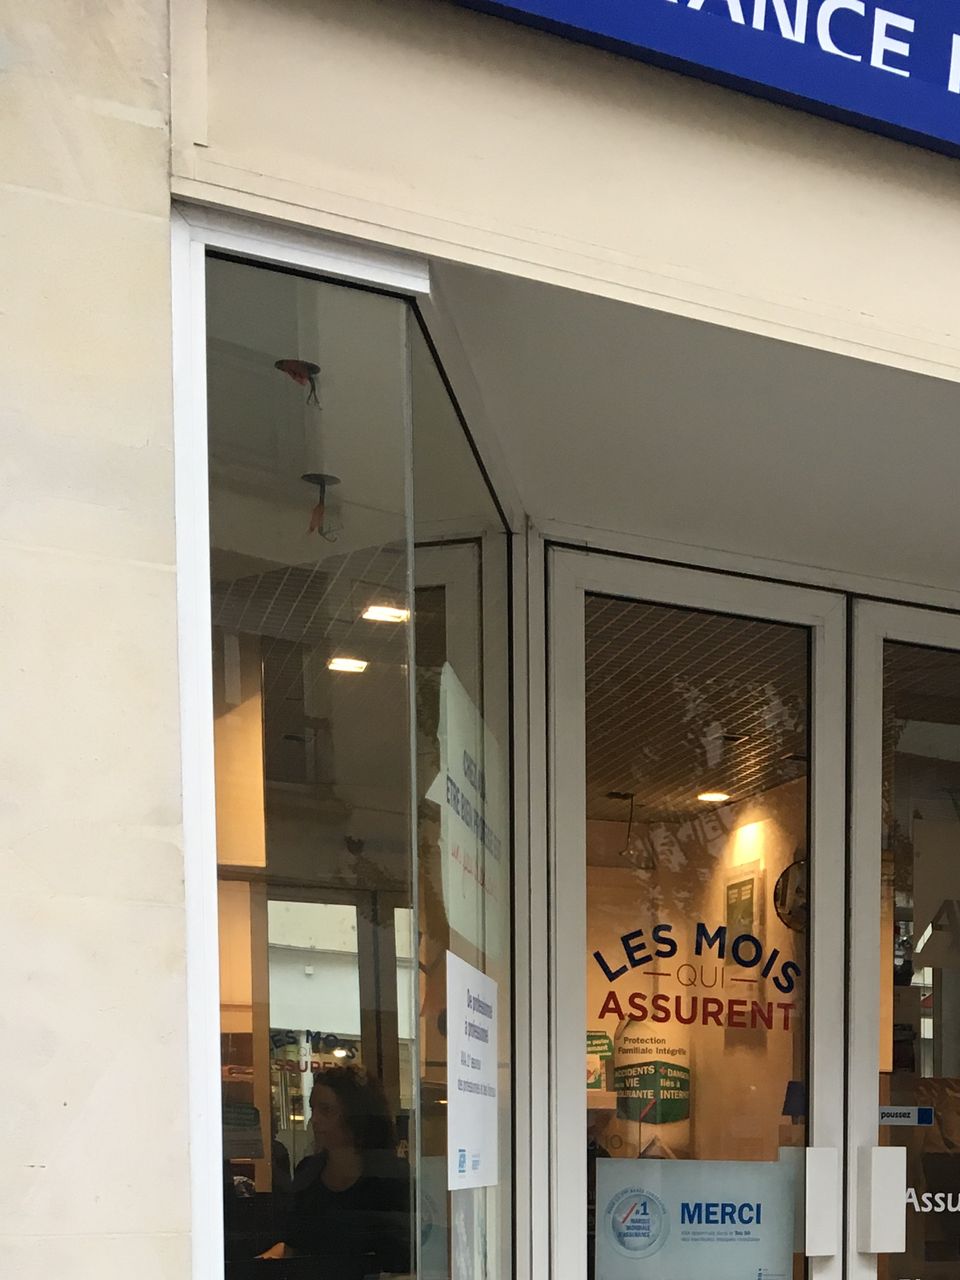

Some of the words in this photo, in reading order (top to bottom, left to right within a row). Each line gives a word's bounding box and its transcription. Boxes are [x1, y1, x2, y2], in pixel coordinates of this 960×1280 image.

[665, 0, 915, 77] NCE
[593, 923, 678, 983] LES
[694, 922, 802, 995] MOIS
[676, 963, 725, 989] QUI
[598, 990, 797, 1032] ASSURENT
[270, 1030, 298, 1050] ES
[618, 1046, 653, 1054] Familiale
[625, 1077, 640, 1087] VIE
[881, 1111, 911, 1120] poussez
[680, 1202, 762, 1225] MERCI
